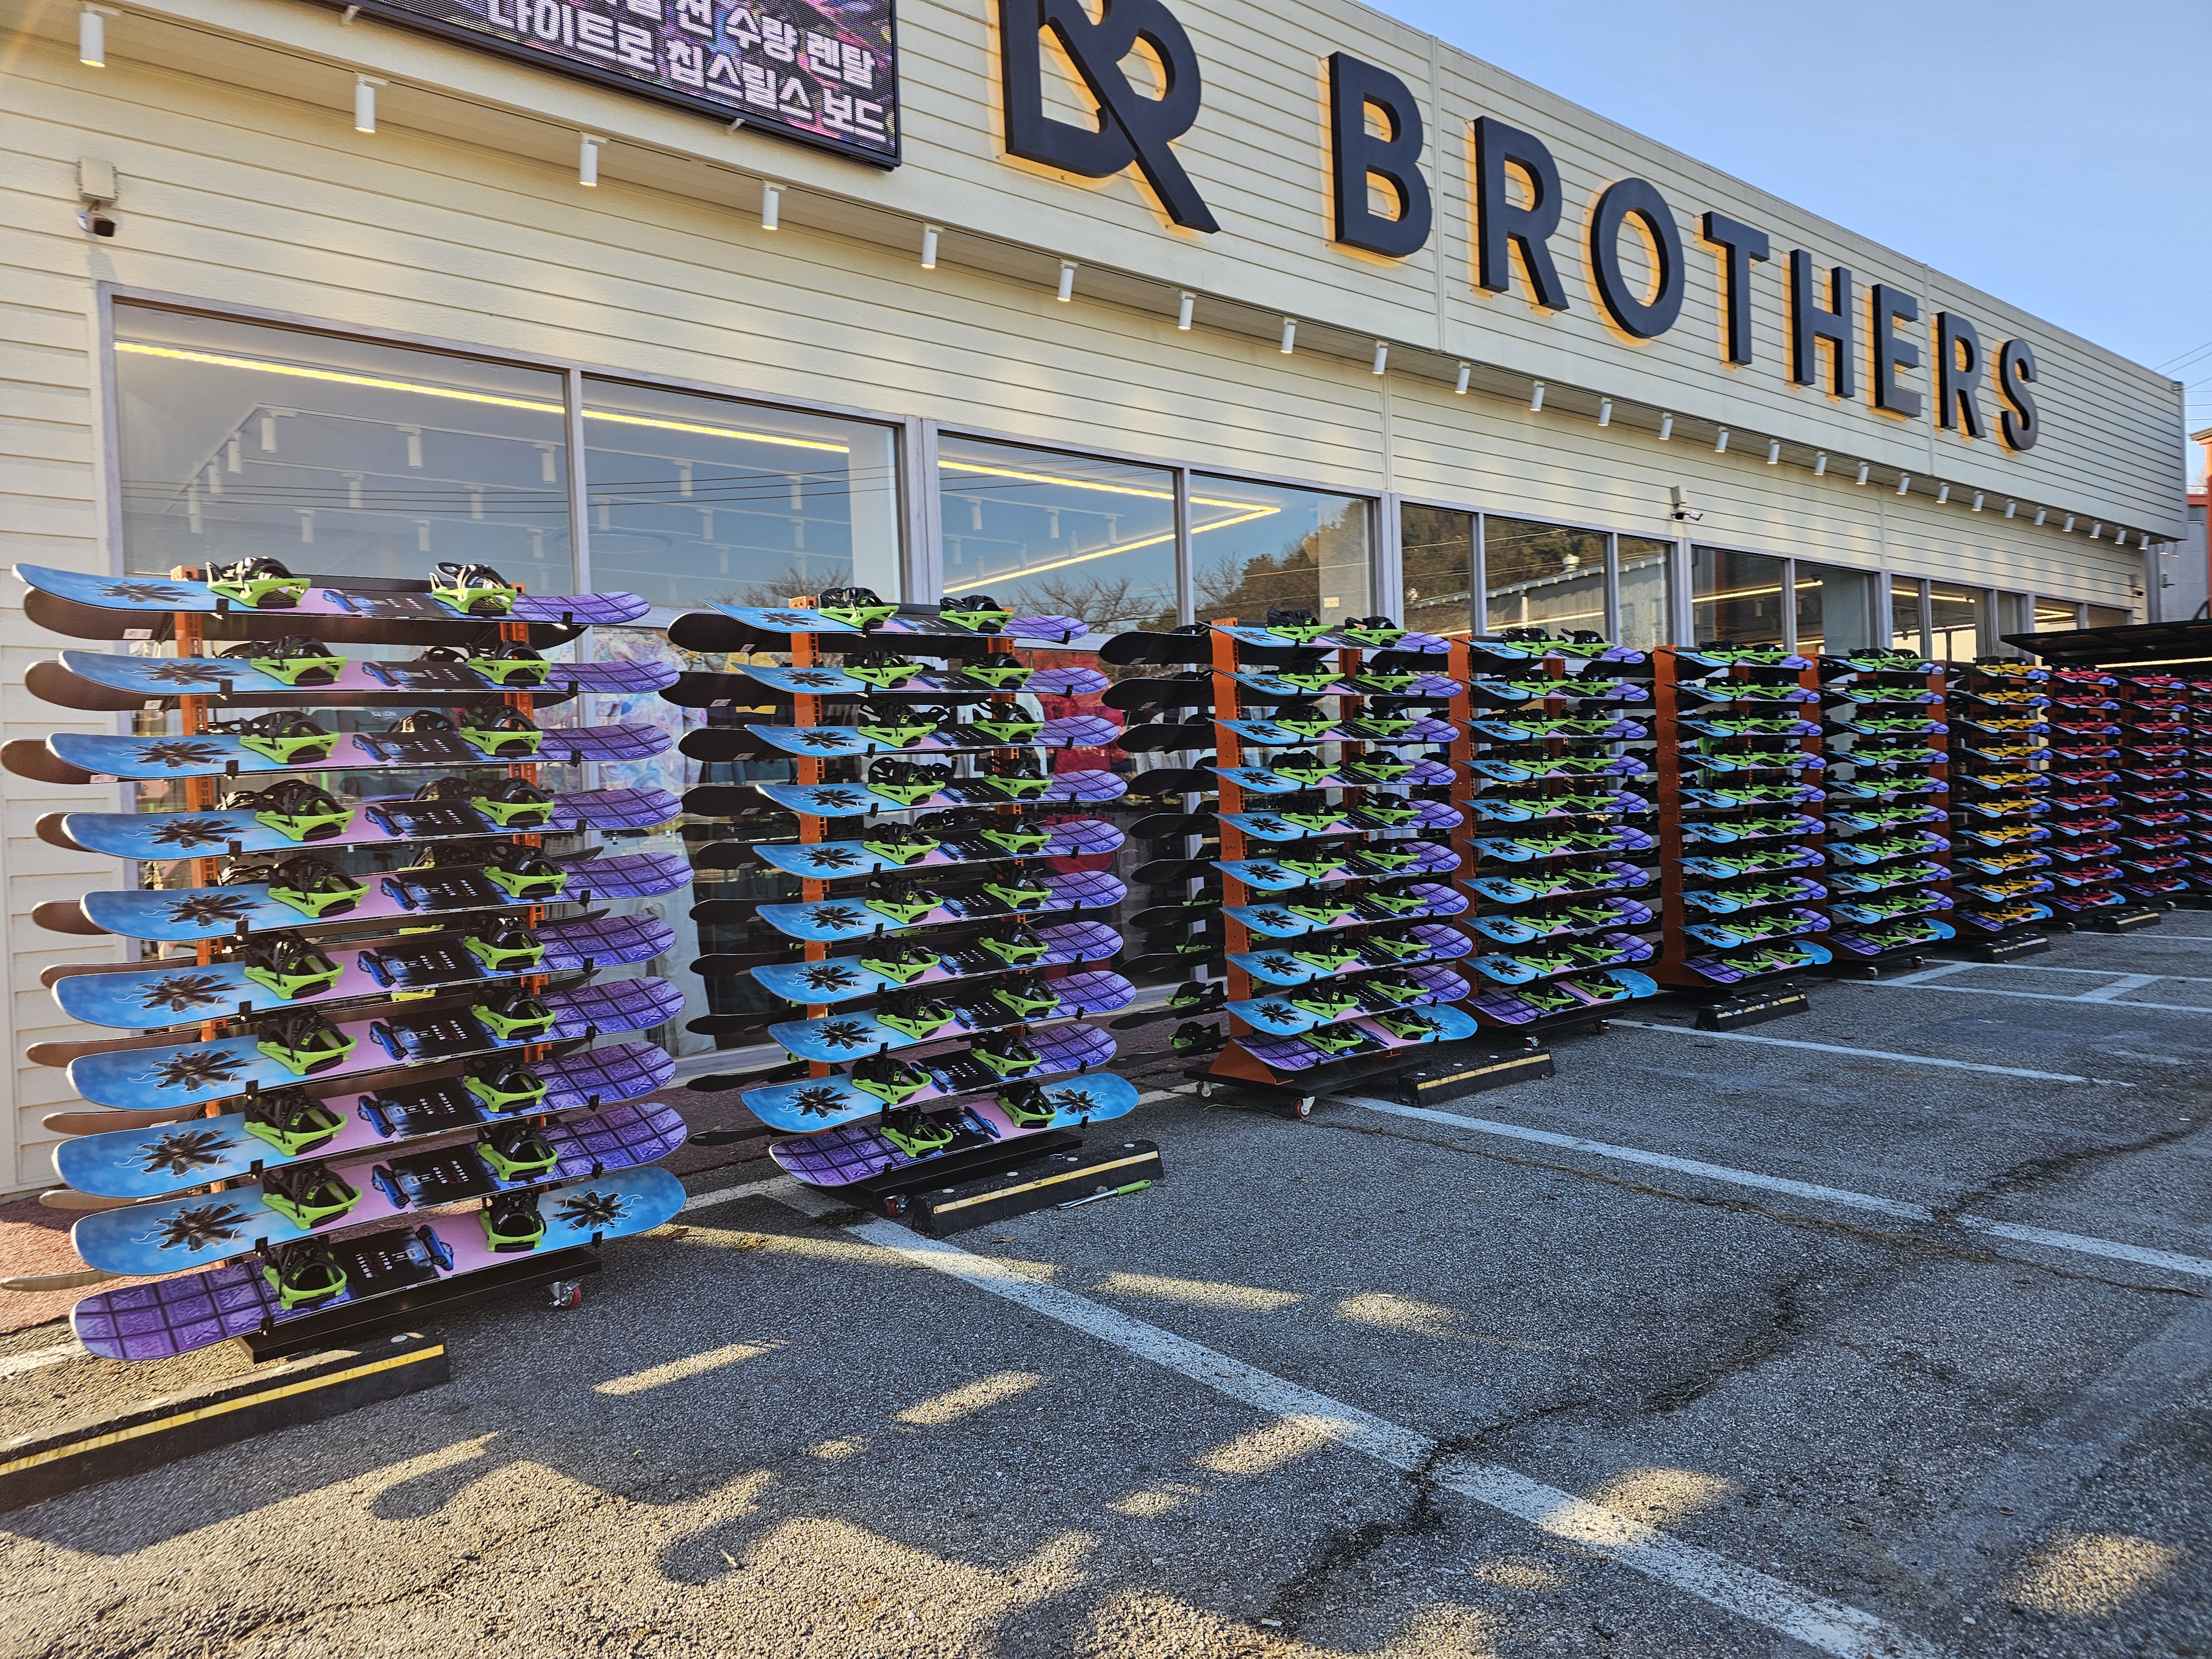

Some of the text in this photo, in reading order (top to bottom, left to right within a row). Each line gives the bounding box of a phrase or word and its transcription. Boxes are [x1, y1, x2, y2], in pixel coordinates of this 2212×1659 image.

[487, 0, 658, 73] 나이트로
[822, 88, 886, 143] 보드
[726, 7, 799, 63] 수량
[806, 31, 875, 90] 렌탈
[1329, 51, 2038, 451] BROTHERS
[378, 1251, 393, 1270] NITRO
